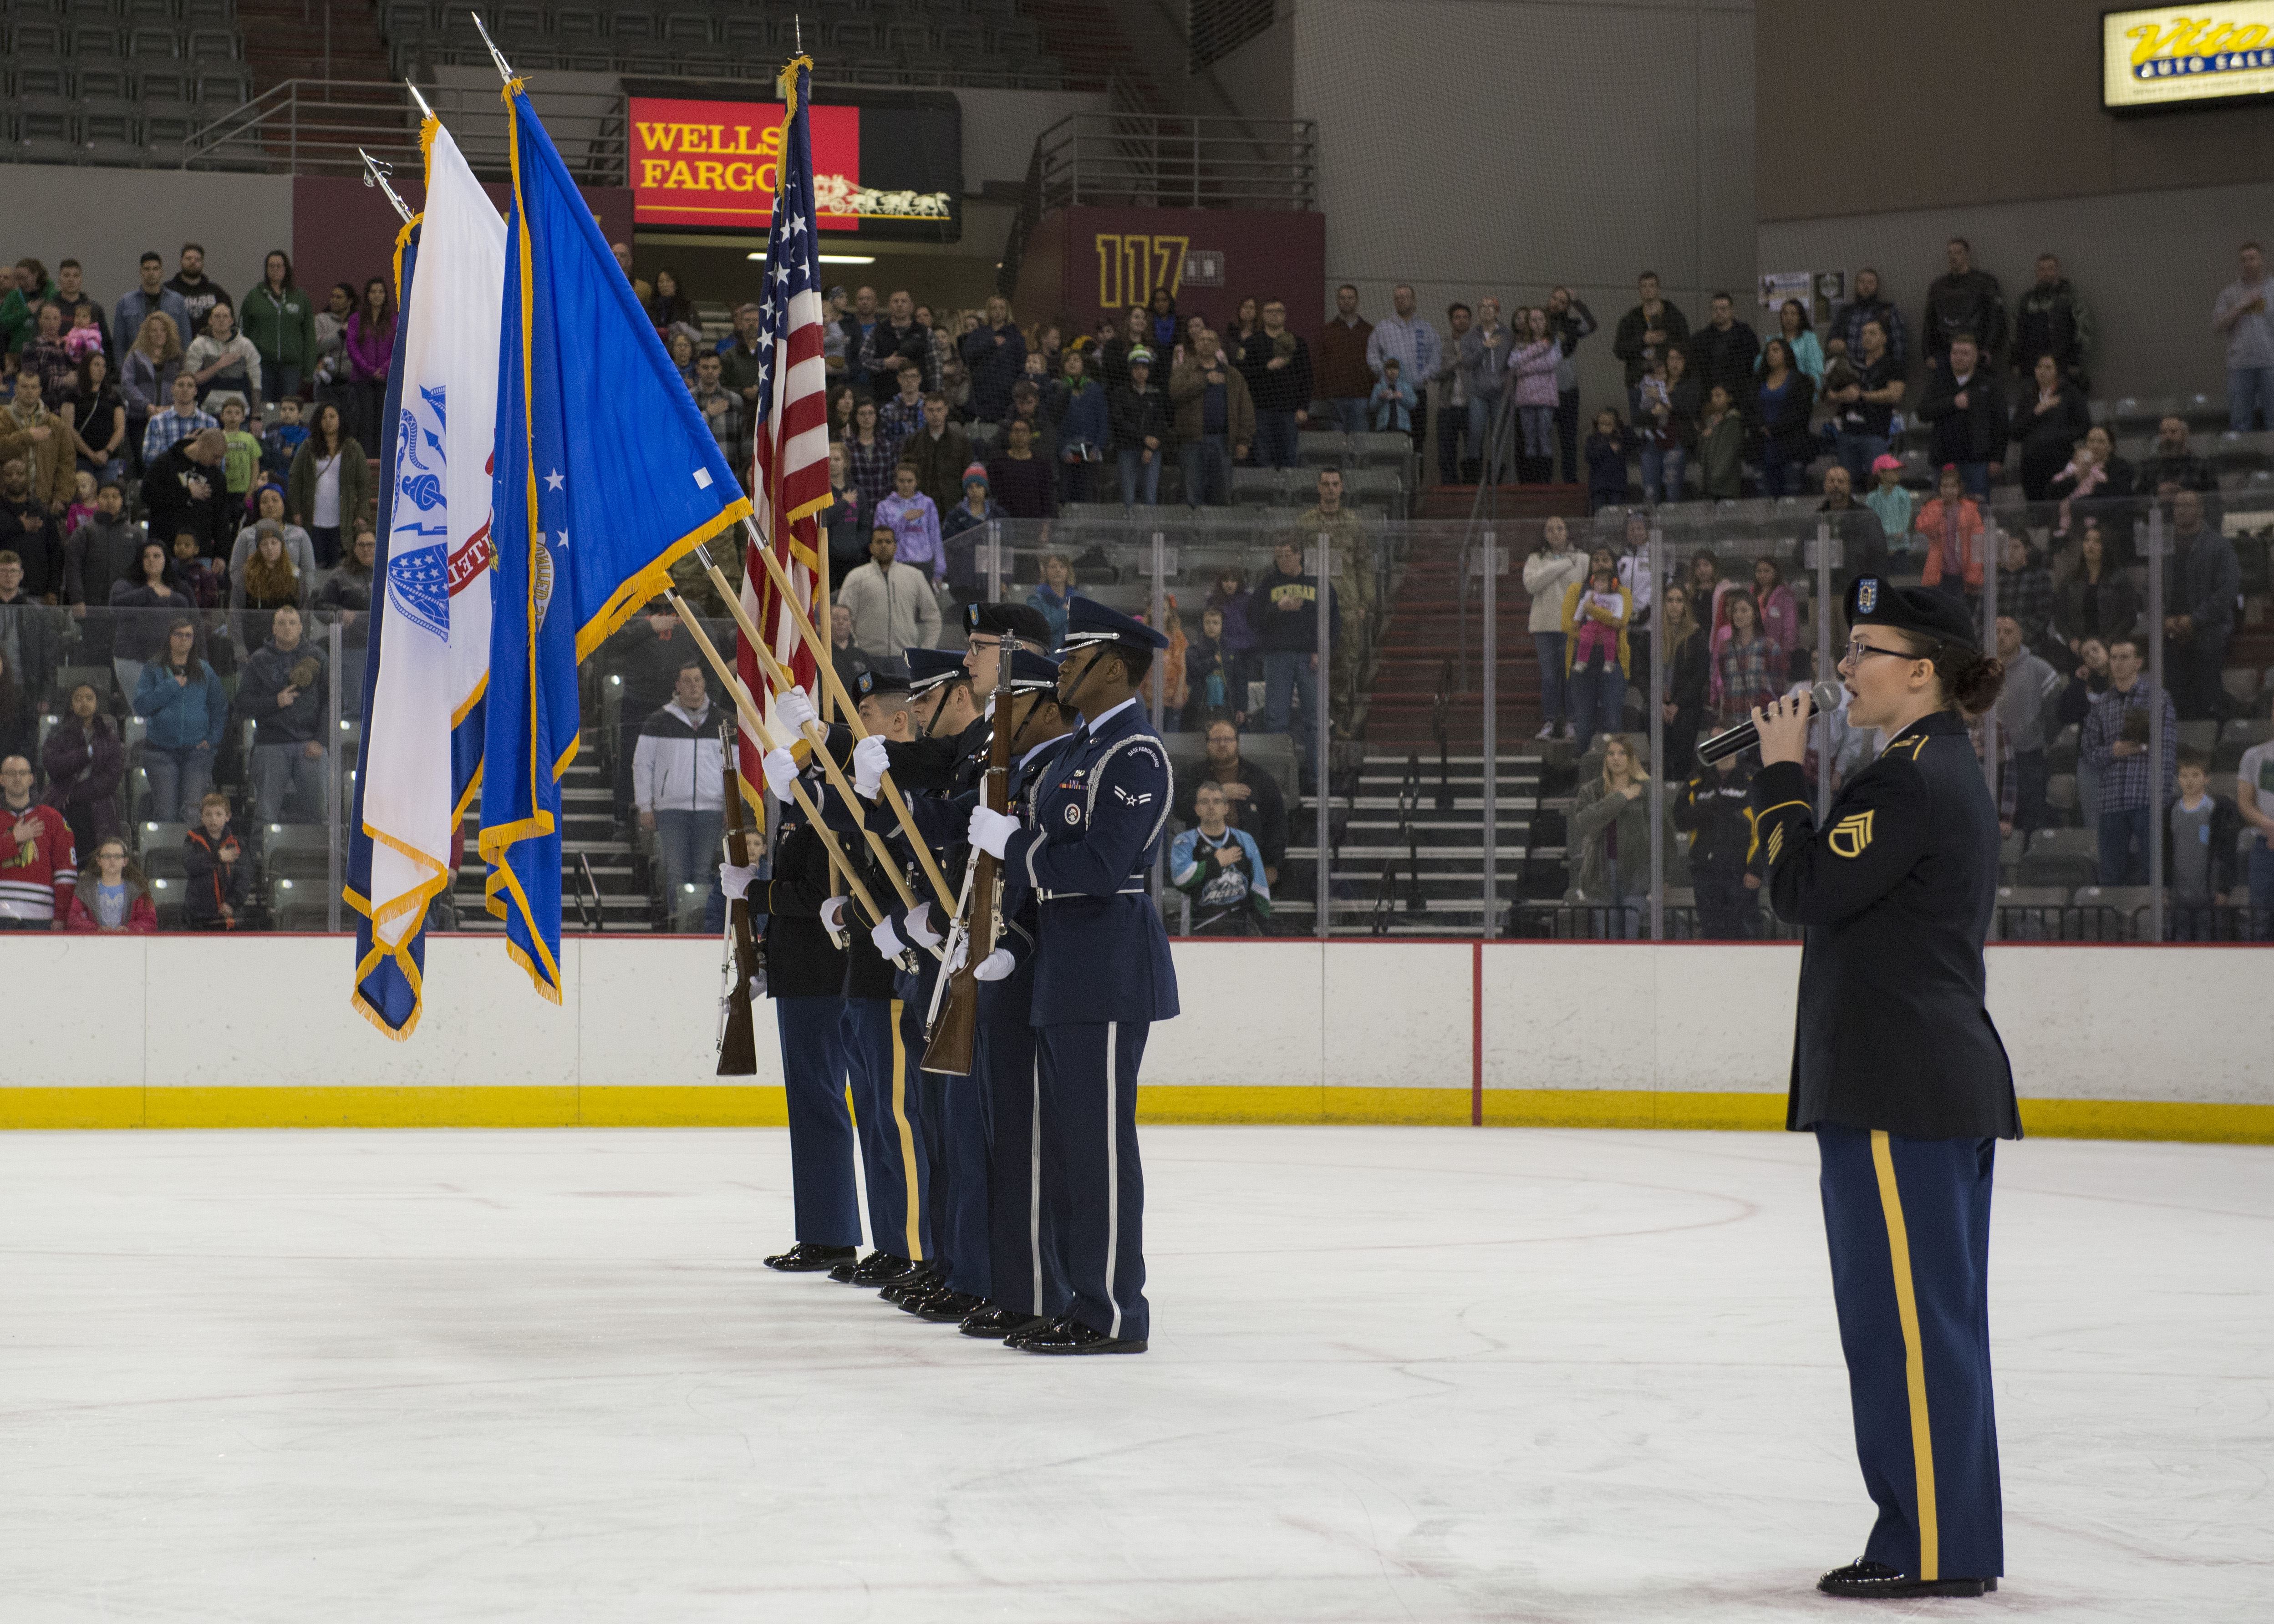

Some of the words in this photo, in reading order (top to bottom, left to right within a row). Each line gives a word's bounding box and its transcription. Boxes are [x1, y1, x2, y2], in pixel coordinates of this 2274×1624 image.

[2141, 56, 2205, 78] AUTO
[636, 122, 781, 156] WELLS
[1095, 233, 1190, 308] 117
[1127, 747, 1139, 756] BASE
[1139, 746, 1153, 755] HONOR
[1151, 752, 1159, 767] GUARD
